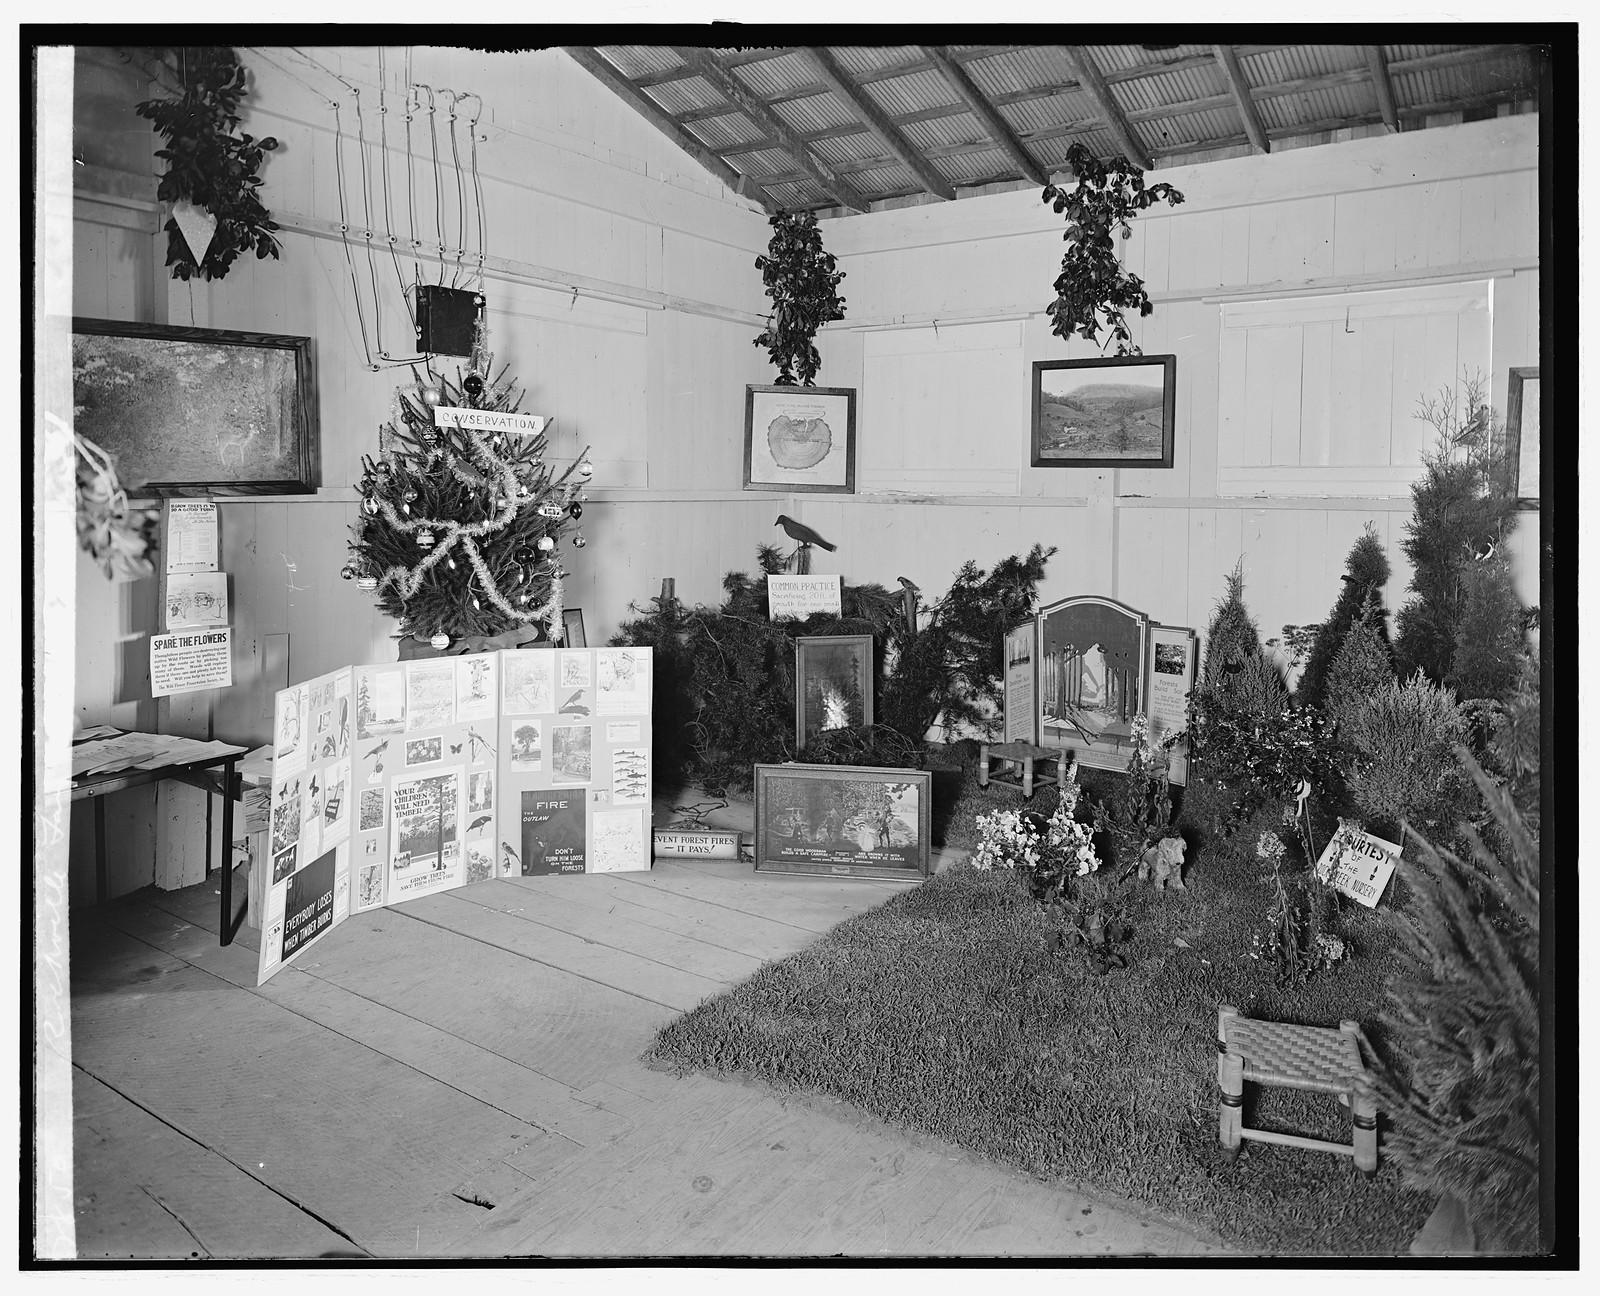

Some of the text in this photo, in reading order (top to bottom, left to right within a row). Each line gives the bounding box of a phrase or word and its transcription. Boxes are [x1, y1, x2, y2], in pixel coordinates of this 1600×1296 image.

[770, 582, 836, 590] COMMON PRACTICE
[772, 592, 806, 600] Sacrificing
[154, 633, 227, 650] SPARE THE FLOWERS
[1154, 684, 1168, 692] Build
[1159, 679, 1178, 688] Forests
[394, 788, 415, 797] YOUR
[394, 792, 428, 804] CHILDREN
[394, 799, 430, 811] WILL NEED
[536, 801, 568, 810] FIRE
[396, 808, 422, 818] TIMBER
[681, 836, 708, 844] FOREST
[711, 837, 734, 846] FIRES
[554, 847, 574, 855] DON'T
[677, 844, 715, 854] IT PAYS!
[1350, 854, 1362, 862] OF
[1344, 862, 1358, 875] THE
[410, 870, 446, 884] GROW TREES
[414, 879, 428, 887] THEM
[428, 876, 442, 884] FROM
[443, 873, 454, 881] FIRE
[1351, 879, 1378, 900] NURSERY
[285, 901, 316, 934] EVERYBODY
[317, 890, 332, 910] LOSES
[284, 932, 299, 953] WHEN
[300, 919, 317, 942] TIMBER
[317, 908, 332, 929] BURNS
